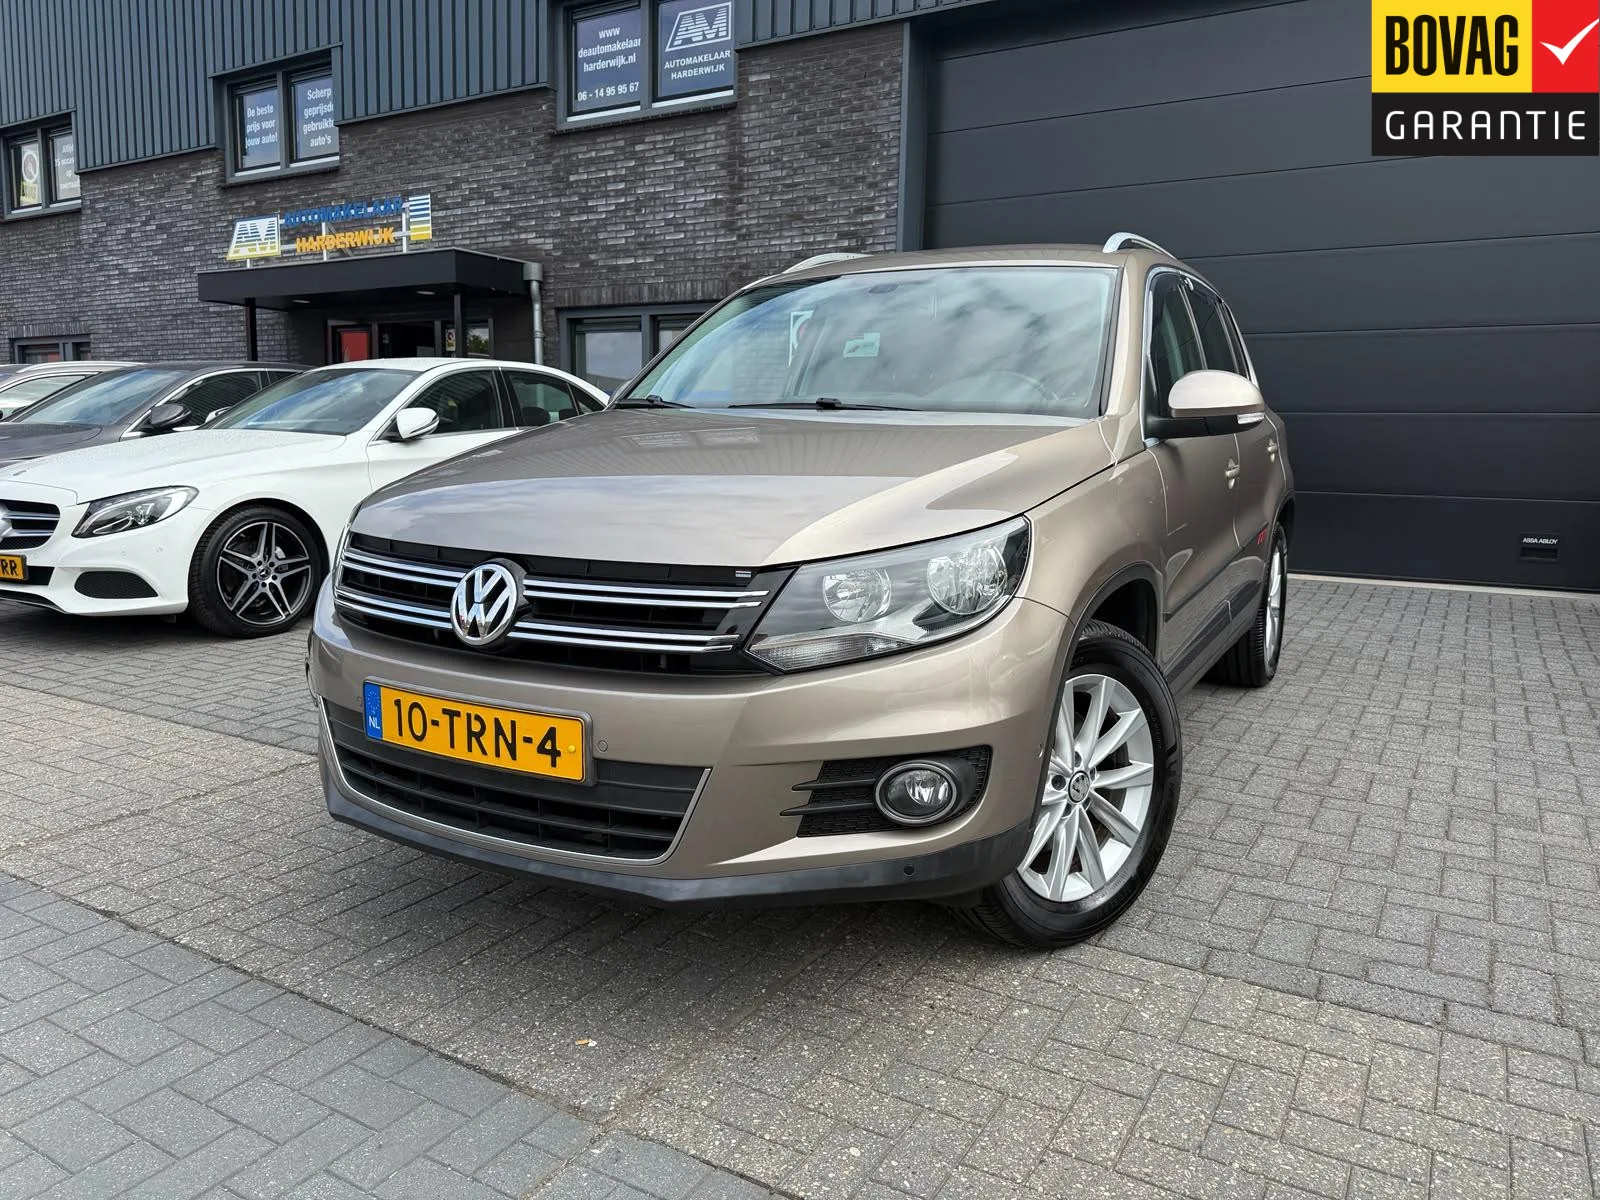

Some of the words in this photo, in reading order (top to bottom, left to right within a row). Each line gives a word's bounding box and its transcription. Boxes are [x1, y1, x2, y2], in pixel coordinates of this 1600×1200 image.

[599, 27, 620, 39] www
[578, 38, 641, 58] deautomakelaar
[583, 52, 636, 72] harderwijk.nl
[664, 50, 731, 69] AUTOMAKELAAR
[671, 64, 726, 80] HARDERWIJK
[307, 88, 331, 100] Scherp
[577, 91, 588, 102] 06
[595, 87, 604, 98] 14
[605, 85, 616, 96] 95
[617, 83, 628, 94] 95
[629, 81, 639, 92] 67
[246, 108, 256, 118] De
[257, 104, 274, 116] beste
[303, 101, 333, 118] geprijsd
[246, 121, 260, 134] prijs
[262, 120, 275, 130] voor
[303, 118, 334, 134] gebruikt
[261, 132, 278, 144] auto!
[310, 134, 332, 147] auto's
[283, 196, 404, 226] AUTOMAKELAAR
[296, 227, 396, 254] HARDERWIJK
[0, 559, 19, 576] RR
[368, 715, 381, 730] NL
[393, 698, 562, 768] 10-TRN-4
